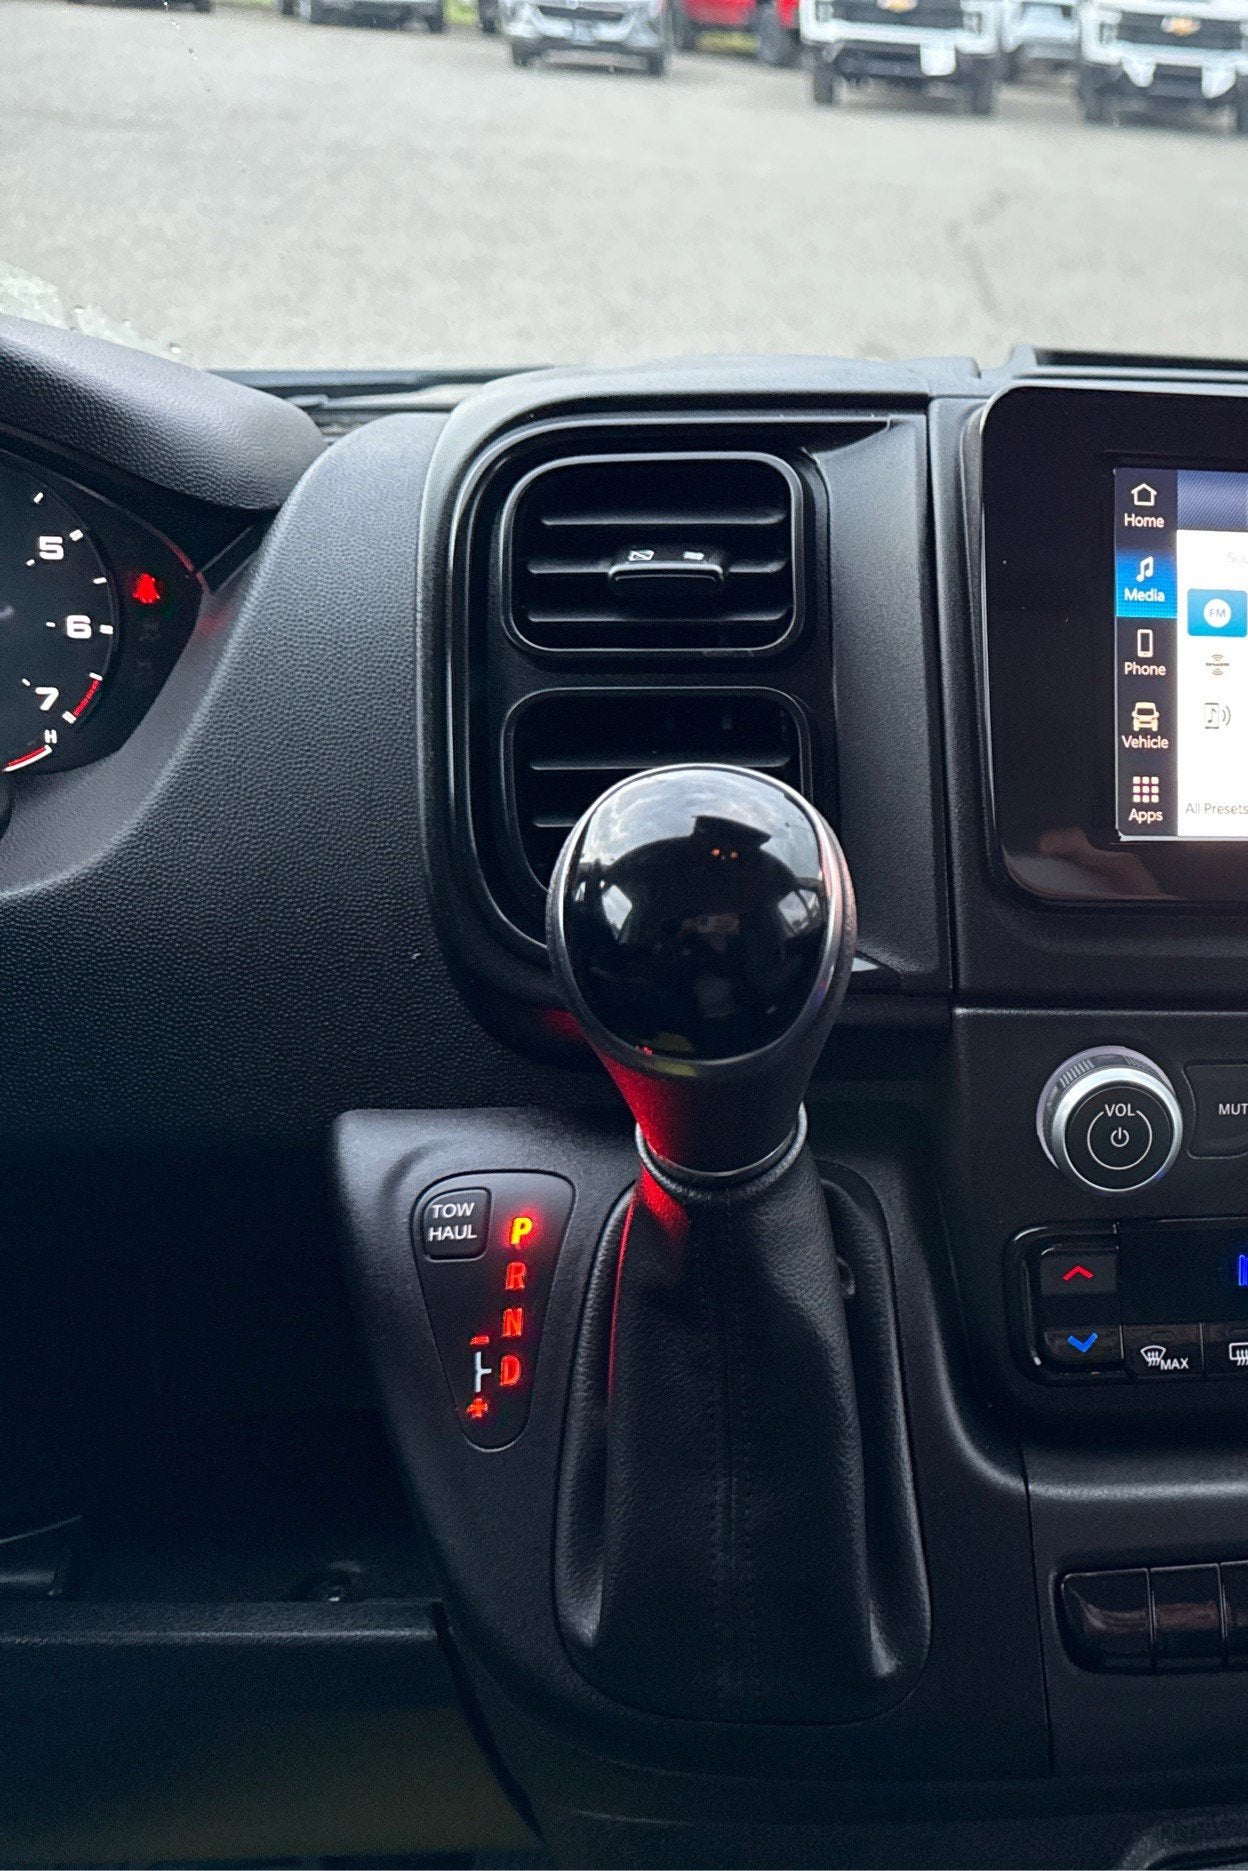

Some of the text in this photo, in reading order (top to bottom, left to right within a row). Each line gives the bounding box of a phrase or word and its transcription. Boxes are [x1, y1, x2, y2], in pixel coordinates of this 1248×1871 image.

[1124, 513, 1165, 528] Home
[39, 535, 64, 560] 5
[1124, 588, 1165, 603] Media
[1208, 607, 1226, 618] FM
[66, 614, 92, 639] 6
[1124, 661, 1166, 676] Phone
[35, 687, 59, 710] 7
[1122, 735, 1169, 749] Vehicle
[1185, 802, 1200, 815] All
[1129, 809, 1163, 824] Apps
[1104, 1104, 1136, 1117] VOL
[432, 1202, 475, 1218] TOW
[428, 1226, 477, 1242] HAUL
[510, 1216, 533, 1245] P
[505, 1262, 526, 1290] R
[502, 1307, 524, 1337] N
[500, 1355, 520, 1386] D
[1160, 1357, 1189, 1370] MAX
